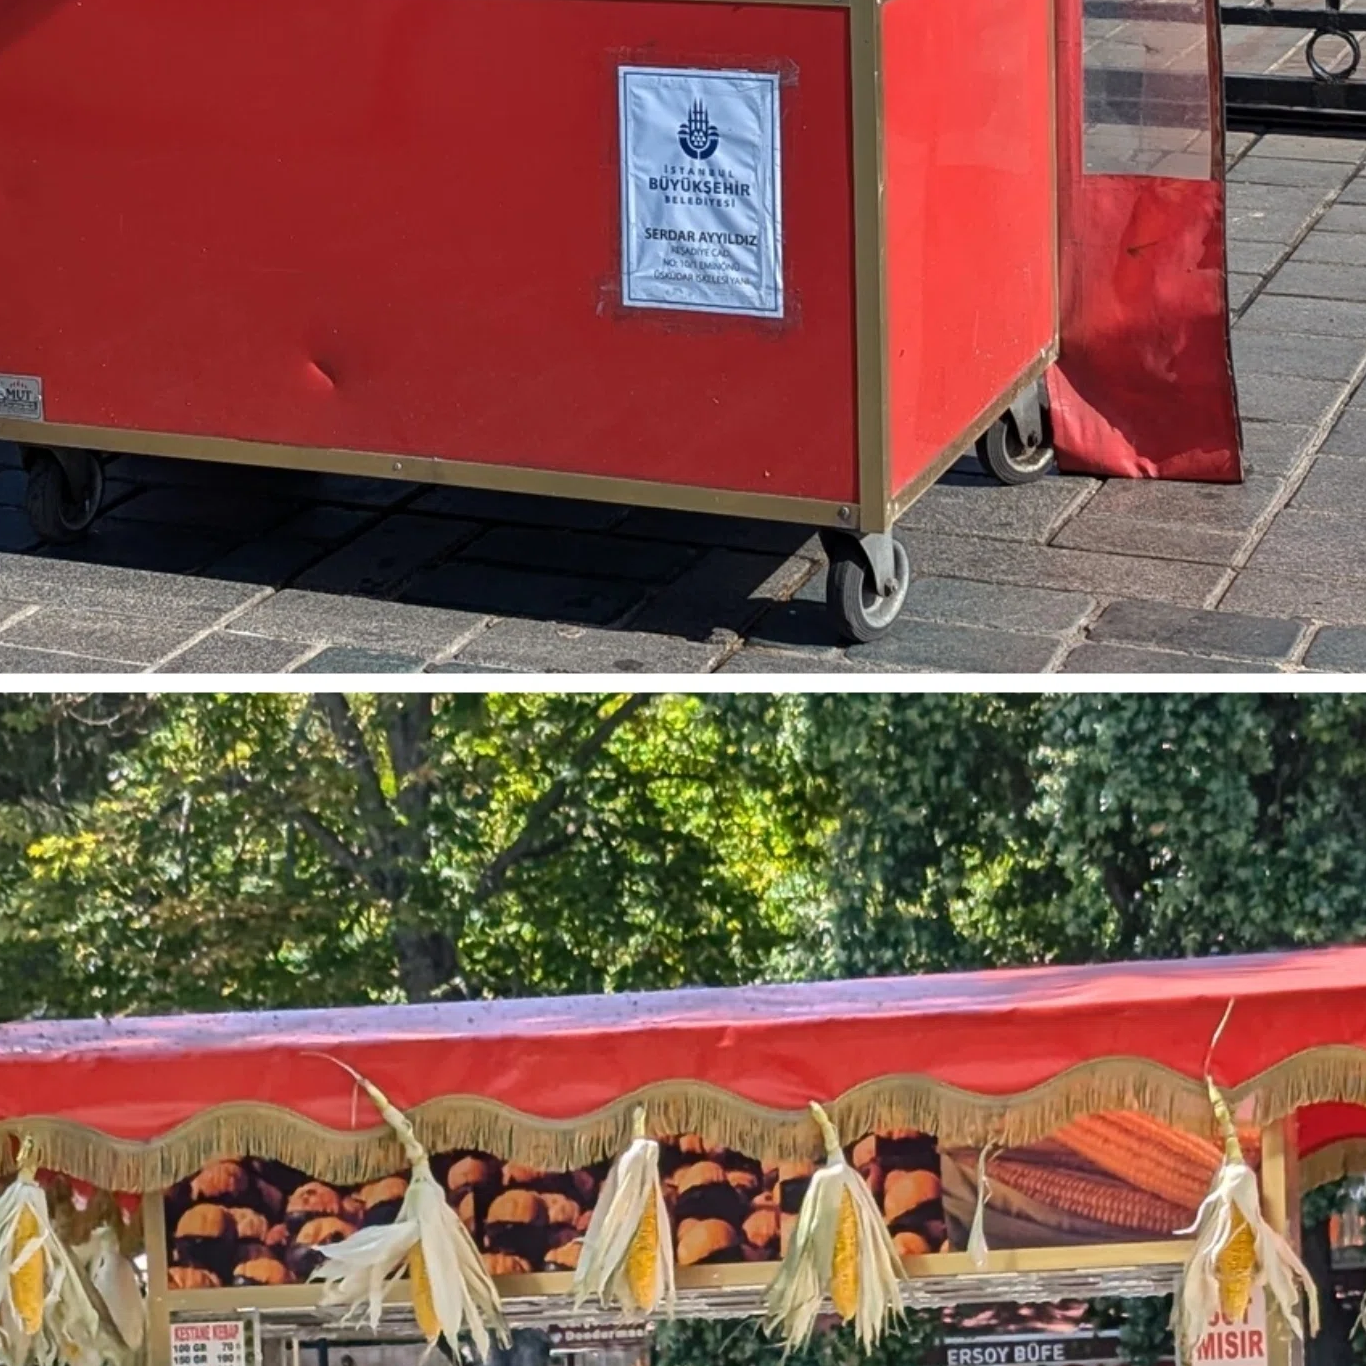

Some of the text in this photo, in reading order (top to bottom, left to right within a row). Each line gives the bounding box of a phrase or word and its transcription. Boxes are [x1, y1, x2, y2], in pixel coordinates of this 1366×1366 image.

[663, 164, 734, 178] İSTANBUL
[649, 175, 751, 197] BÜYÜKŞEHİR
[664, 195, 736, 208] BELEDİYESİ
[645, 228, 758, 246] SERDAR AYYILDIZ
[947, 1343, 1066, 1366] ERSOY BÜFE
[1197, 1329, 1264, 1360] MISIR
